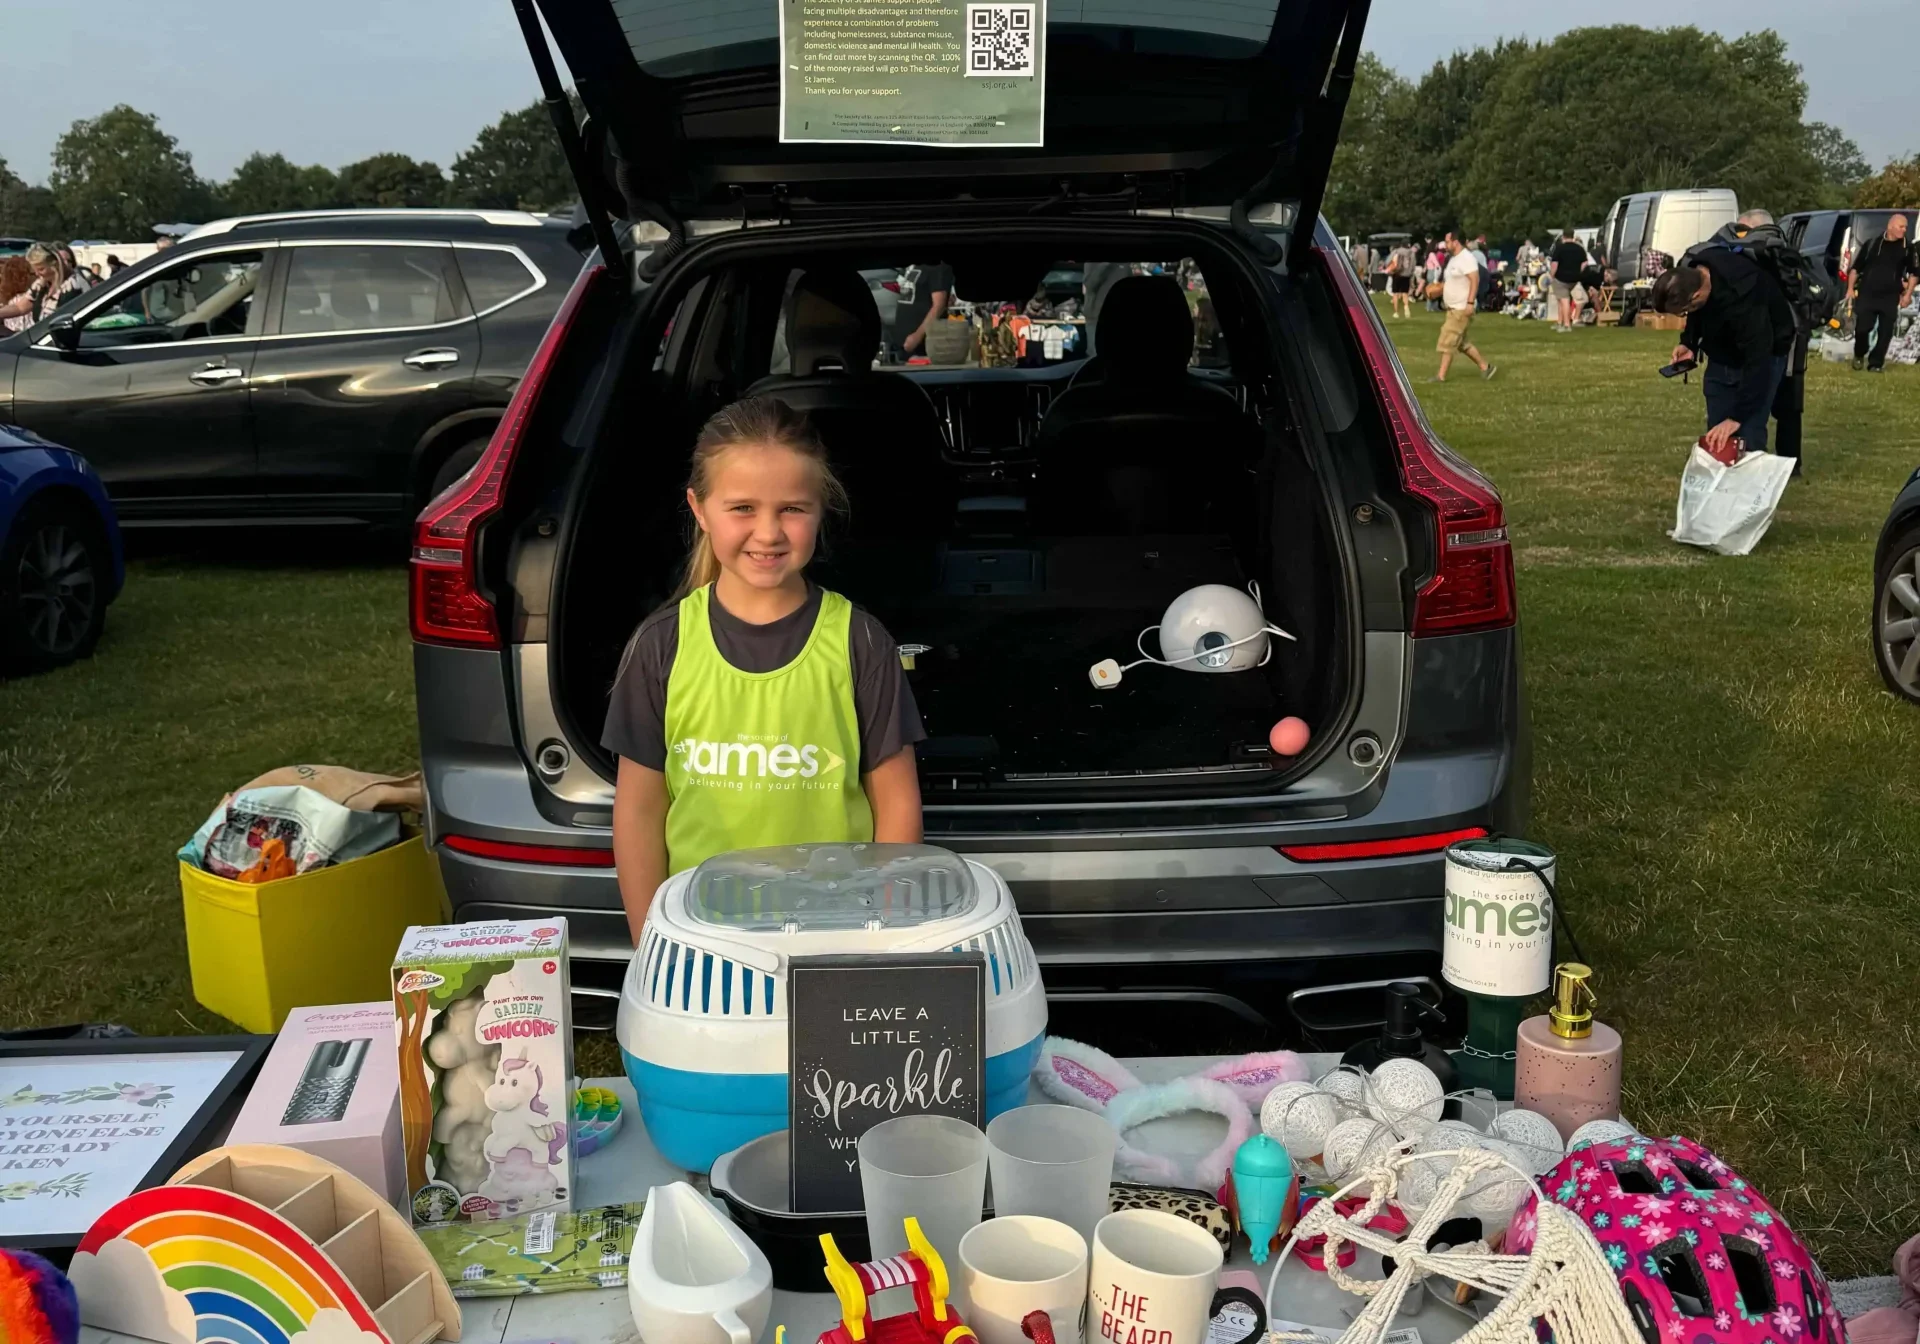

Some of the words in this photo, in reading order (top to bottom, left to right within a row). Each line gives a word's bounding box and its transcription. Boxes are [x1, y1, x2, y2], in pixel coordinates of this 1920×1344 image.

[803, 7, 824, 16] facing
[826, 7, 855, 16] multiple
[857, 7, 907, 16] disadvantages
[909, 7, 922, 15] and
[924, 7, 958, 15] therefore
[803, 19, 842, 27] experience
[850, 19, 894, 27] combination
[896, 19, 904, 27] of
[905, 19, 939, 27] problems
[804, 30, 836, 39] including
[837, 30, 888, 39] homelessness,
[890, 30, 925, 38] substance
[927, 31, 954, 39] misuse,
[804, 42, 836, 50] domestic
[838, 42, 867, 50] violence
[869, 42, 882, 50] and
[884, 42, 909, 50] mental
[918, 42, 943, 50] health.
[946, 42, 960, 50] You
[818, 53, 832, 61] find
[833, 53, 846, 61] out
[868, 53, 876, 62] by
[878, 54, 909, 62] scanning
[911, 53, 923, 61] the
[924, 53, 937, 61] QR.
[941, 53, 960, 61] 100%
[826, 66, 851, 74] money
[889, 66, 899, 74] go
[924, 65, 949, 74] Society
[981, 81, 1018, 90] ssj.org.uk
[804, 87, 826, 95] Thank
[842, 87, 852, 95] for
[737, 733, 750, 741] the
[751, 734, 779, 742] society
[780, 733, 788, 741] of
[689, 777, 743, 791] believing
[750, 780, 761, 789] in
[768, 782, 796, 792] your
[802, 780, 839, 790] future
[1482, 870, 1521, 880] vulnerable
[1472, 889, 1490, 900] the
[1495, 892, 1535, 901] society
[460, 928, 514, 938] GARDEN
[443, 935, 525, 948] UNICORN
[1488, 939, 1501, 948] in
[1509, 940, 1537, 951] your
[493, 997, 510, 1006] PAINT
[494, 1002, 543, 1018] GARDEN
[843, 1007, 907, 1022] LEAVE
[916, 1007, 929, 1020] A
[483, 1019, 556, 1041] UNICORN
[851, 1030, 921, 1045] LITTLE
[803, 1048, 964, 1131] Sparkle
[4, 1112, 159, 1127] YOURSELF
[88, 1126, 165, 1138] ELSE
